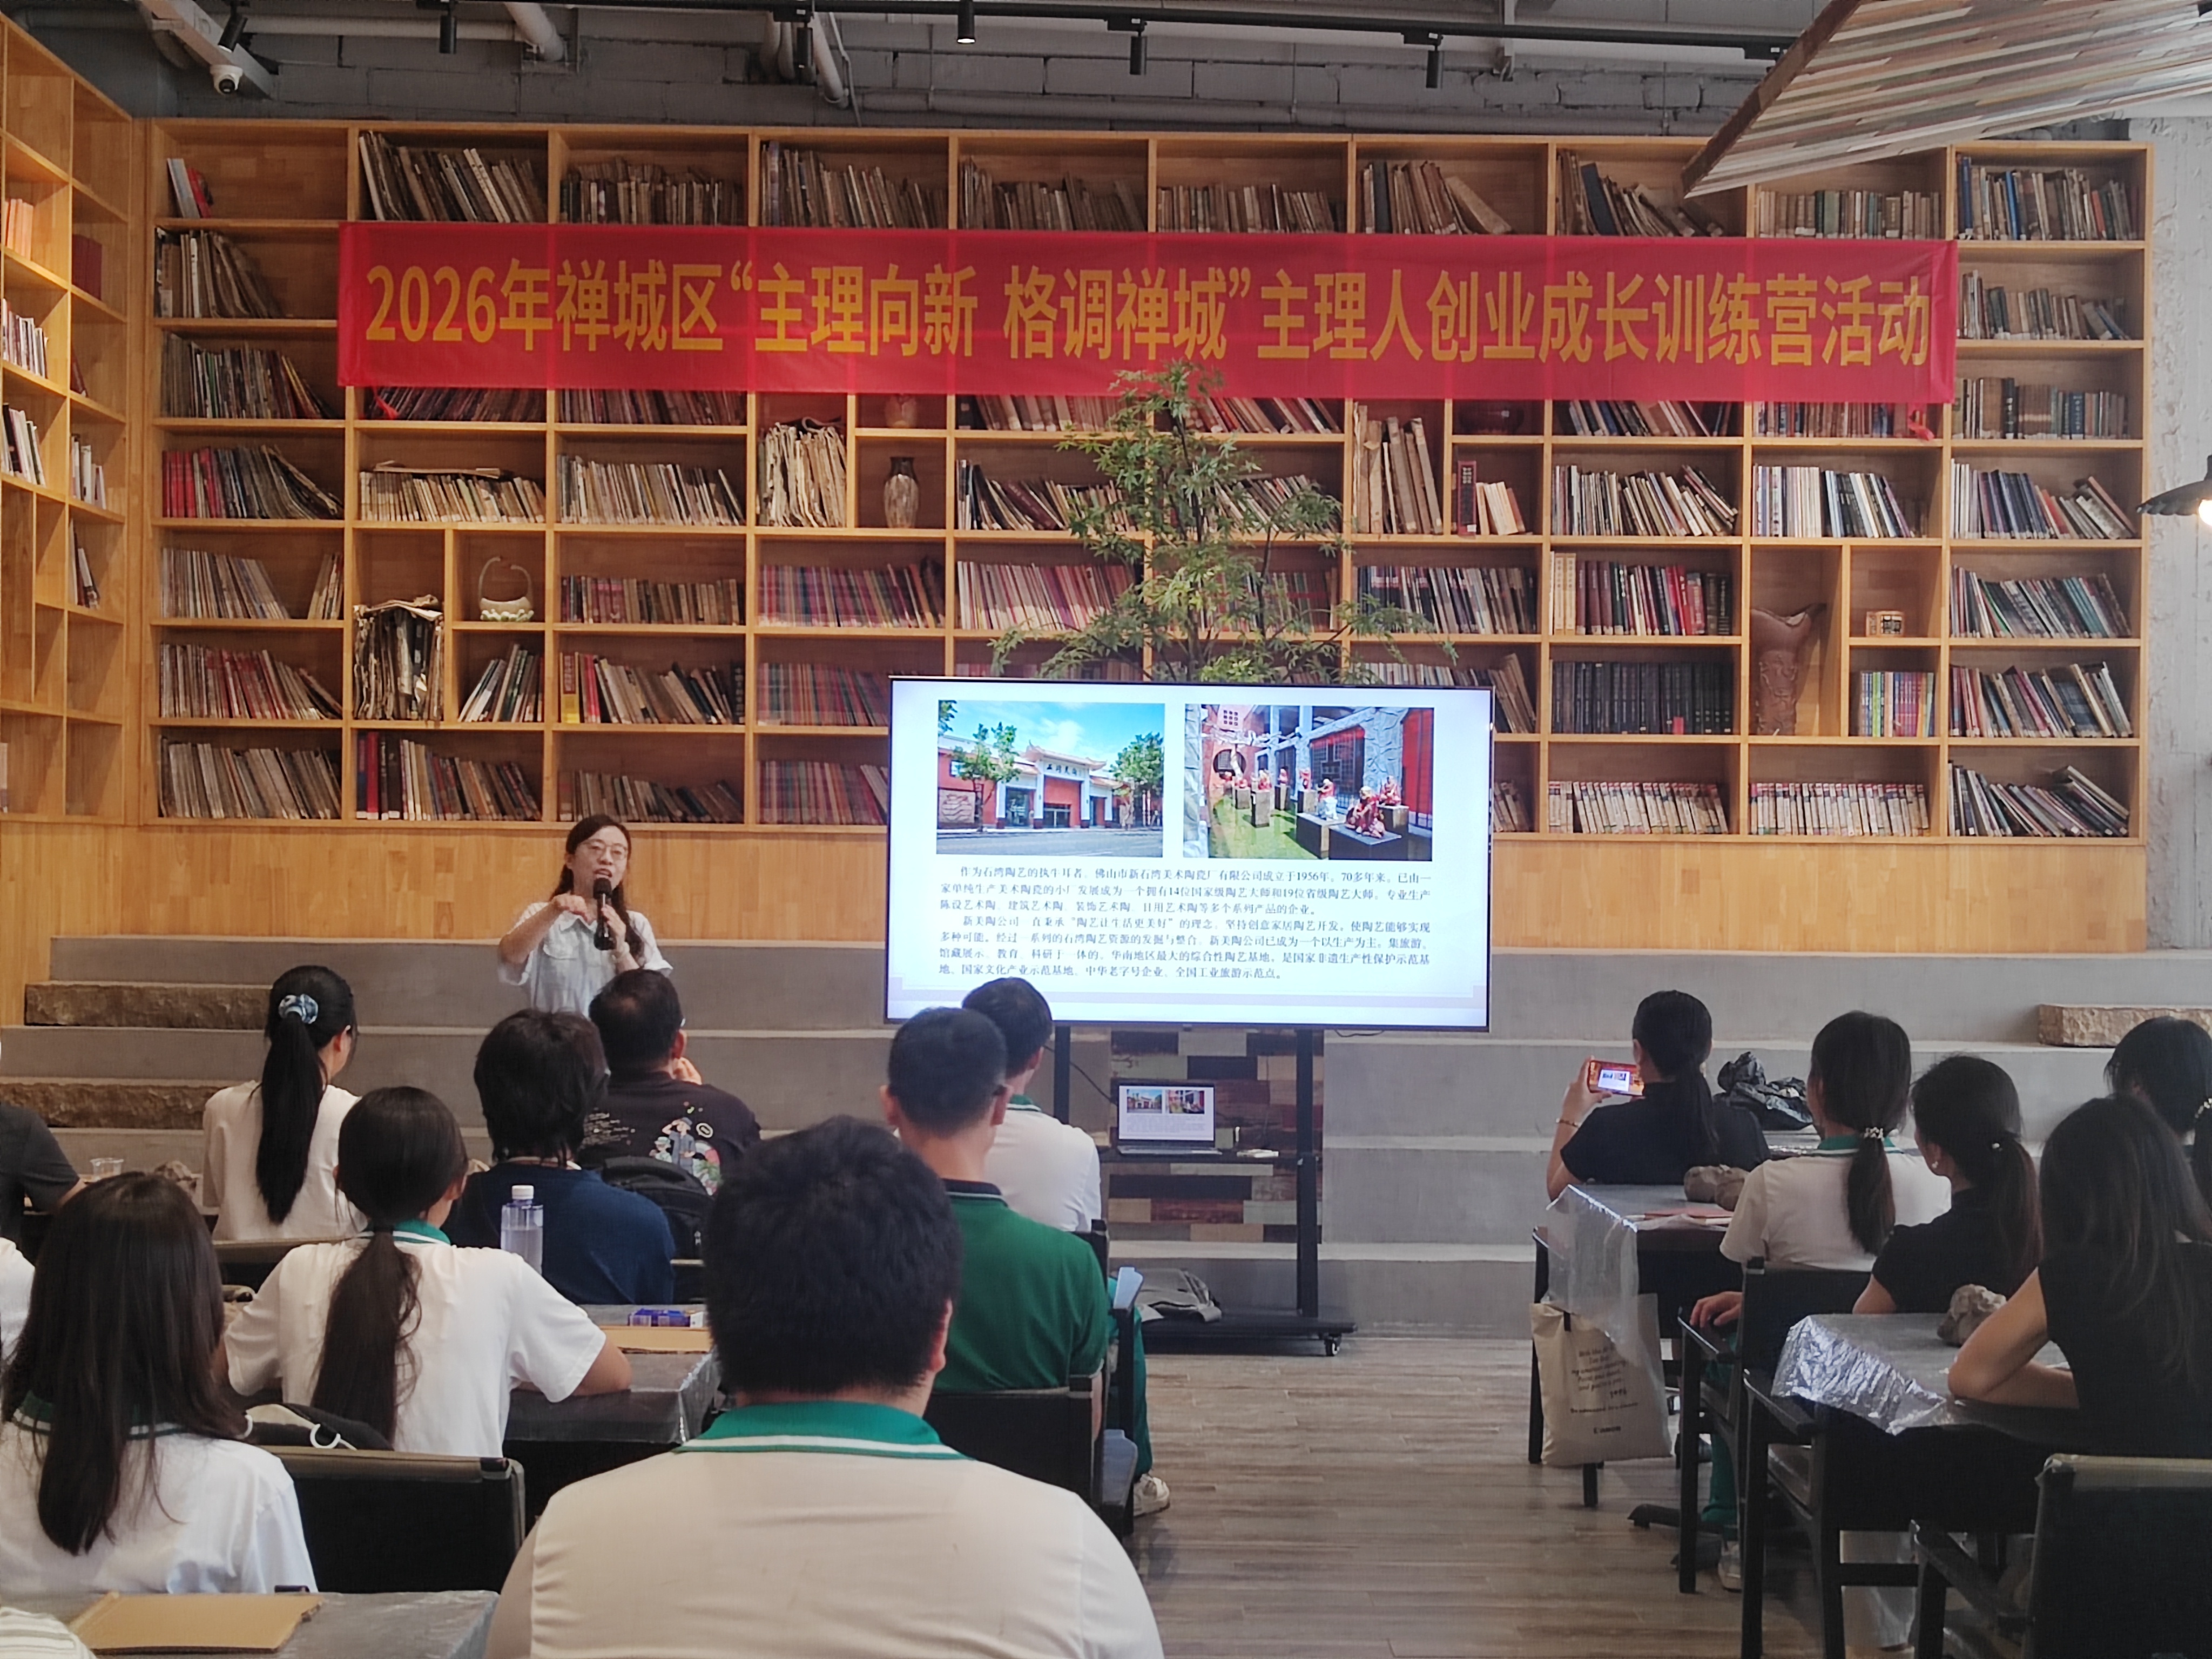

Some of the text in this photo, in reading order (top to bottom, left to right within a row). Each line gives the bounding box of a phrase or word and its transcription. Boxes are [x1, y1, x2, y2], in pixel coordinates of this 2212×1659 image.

[366, 258, 1928, 366] 2026年禅城区“主理向新 格调禅城”主理人创业成长训练营活动
